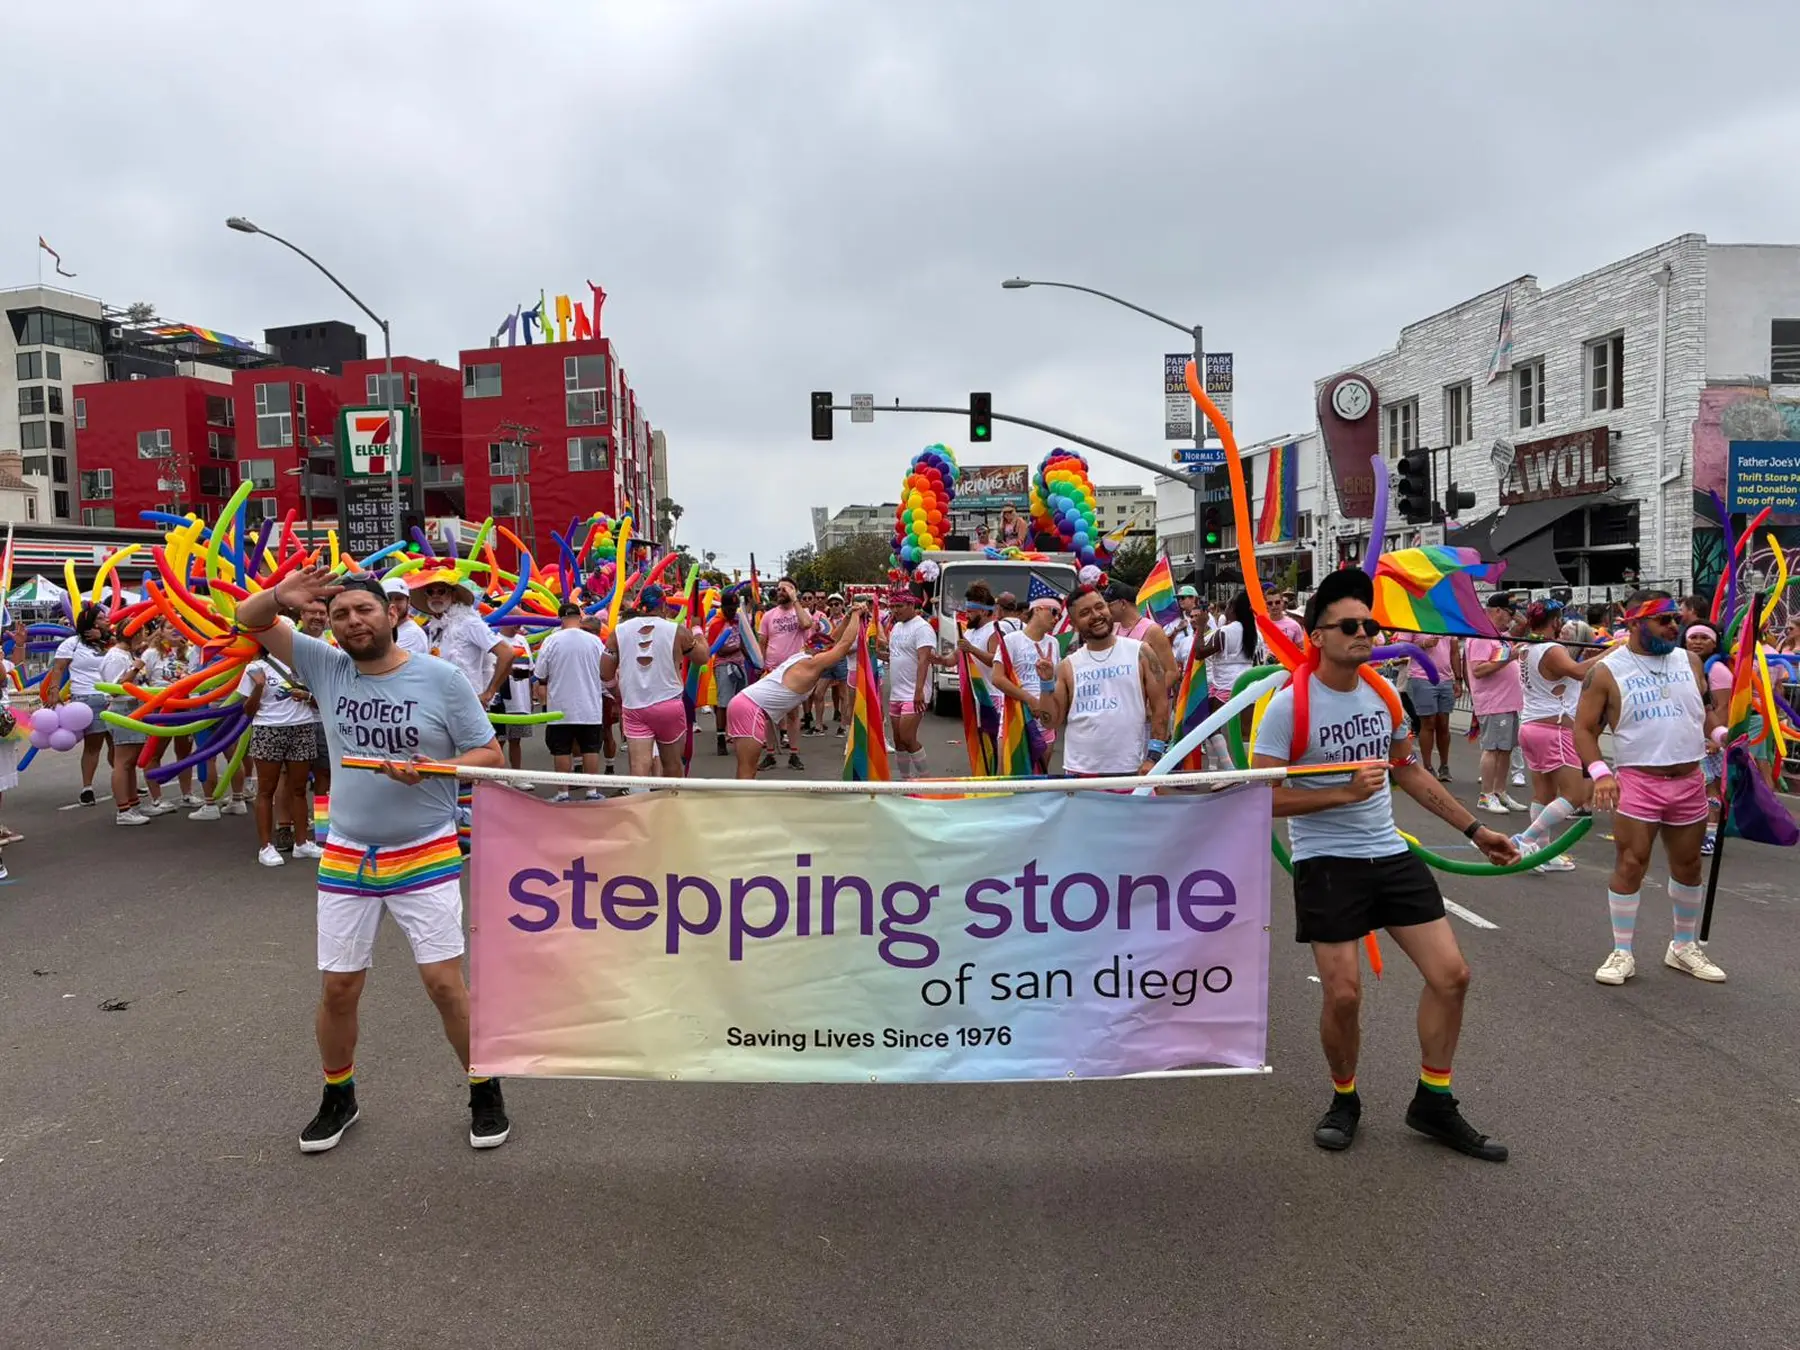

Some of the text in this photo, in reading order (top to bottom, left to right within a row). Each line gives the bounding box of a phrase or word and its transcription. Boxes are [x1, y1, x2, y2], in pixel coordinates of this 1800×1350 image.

[1207, 356, 1231, 364] PARK
[1166, 366, 1186, 374] FRE
[1207, 365, 1231, 373] FREE
[1207, 382, 1231, 391] DMV
[355, 444, 397, 456] ELEVE
[1502, 440, 1606, 496] AWOL
[1738, 456, 1768, 467] Father
[1769, 456, 1793, 467] Joe's
[1738, 472, 1762, 481] Thrift
[1765, 473, 1789, 481] Store
[955, 475, 1004, 496] URIOUS
[1737, 485, 1797, 493] and Donation
[1737, 496, 1798, 507] Drop off only.
[1076, 664, 1133, 681] PROTECT
[1076, 683, 1101, 698] THE
[1630, 690, 1660, 705] THE
[336, 696, 418, 723] PROTECT
[1076, 697, 1118, 713] DOLLS
[1633, 703, 1684, 722] DOLLS
[1319, 710, 1386, 747] PROTECT
[356, 725, 419, 754] DOLLS
[1343, 735, 1391, 763] DOLLS
[508, 853, 1237, 968] stepping stone
[921, 953, 1234, 1007] of san diego
[726, 1025, 1012, 1052] Saving Lives Since 1976
